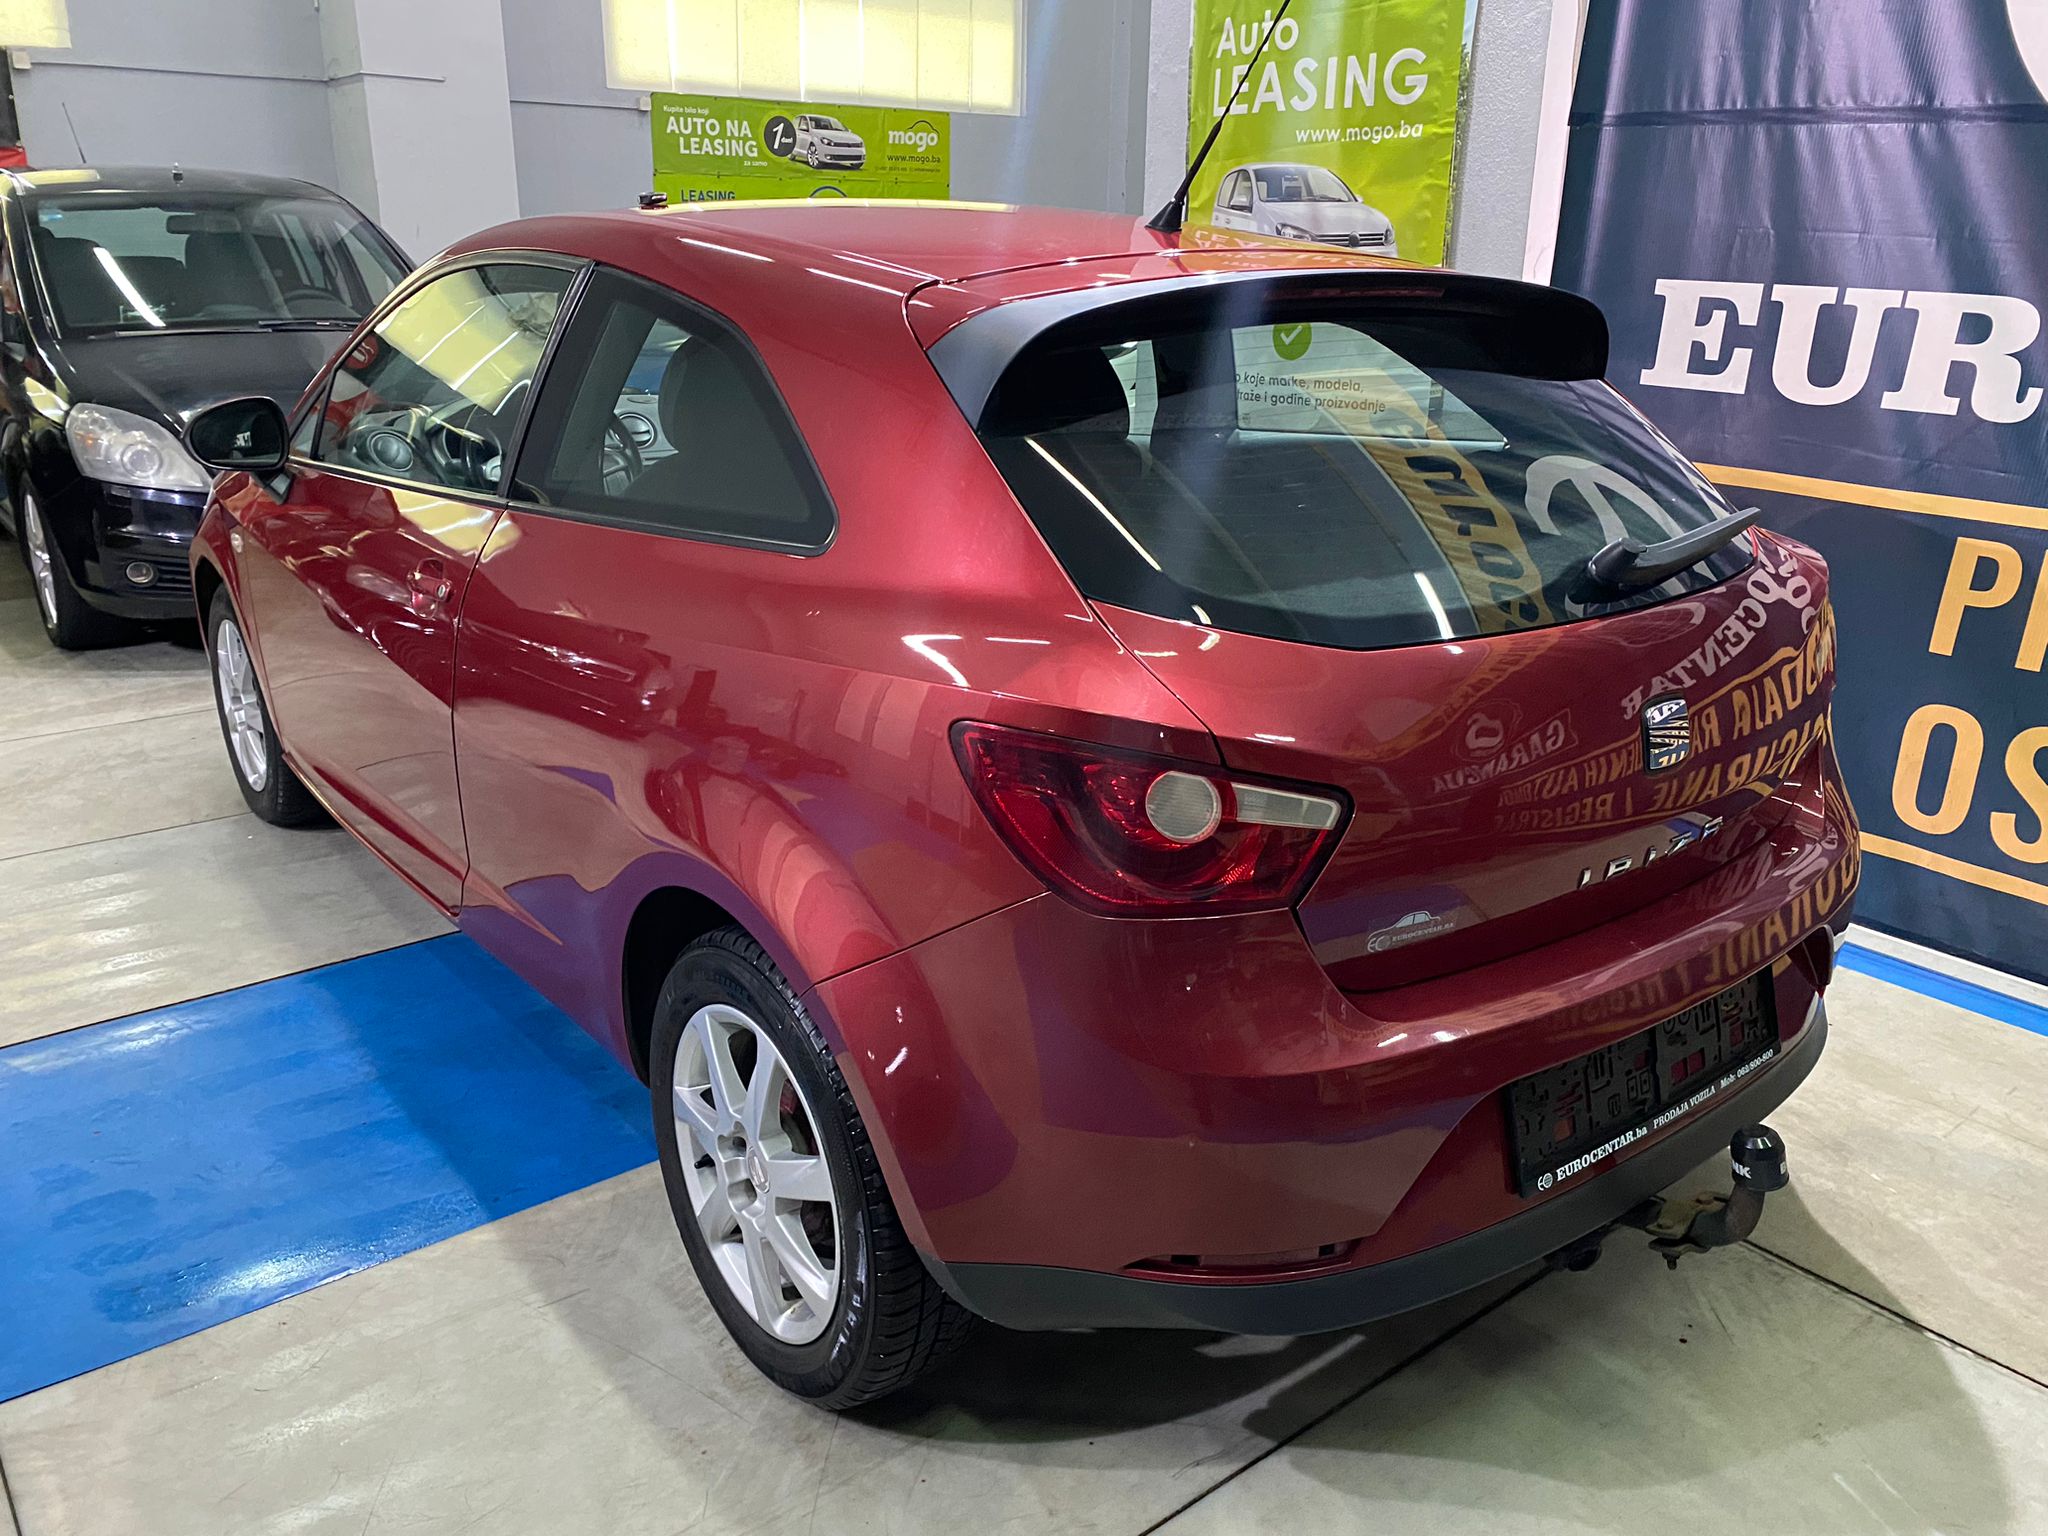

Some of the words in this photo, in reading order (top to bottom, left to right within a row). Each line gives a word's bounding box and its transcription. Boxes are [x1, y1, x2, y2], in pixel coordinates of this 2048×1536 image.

[1216, 10, 1299, 59] Auto
[1213, 48, 1428, 118] LEASING
[667, 116, 720, 136] AUTO
[726, 120, 752, 137] NA
[772, 122, 784, 150] 1
[1296, 121, 1424, 144] www.mogo.ba
[680, 137, 758, 157] LEASING
[888, 130, 938, 153] mogo
[887, 155, 941, 165] www.mogo.ba
[681, 189, 736, 201] LEASING
[1639, 278, 2045, 424] EUR
[1244, 372, 1265, 389] koje
[1268, 374, 1310, 390] marke,
[1313, 379, 1364, 393] modela,
[1264, 391, 1268, 402] i
[1271, 394, 1311, 407] godine
[1314, 397, 1386, 415] proizvodnje
[1556, 1126, 1648, 1182] EUROCENTAR.ba
[1653, 1102, 1689, 1129] PRODAJA
[1689, 1085, 1716, 1107] VOZILA
